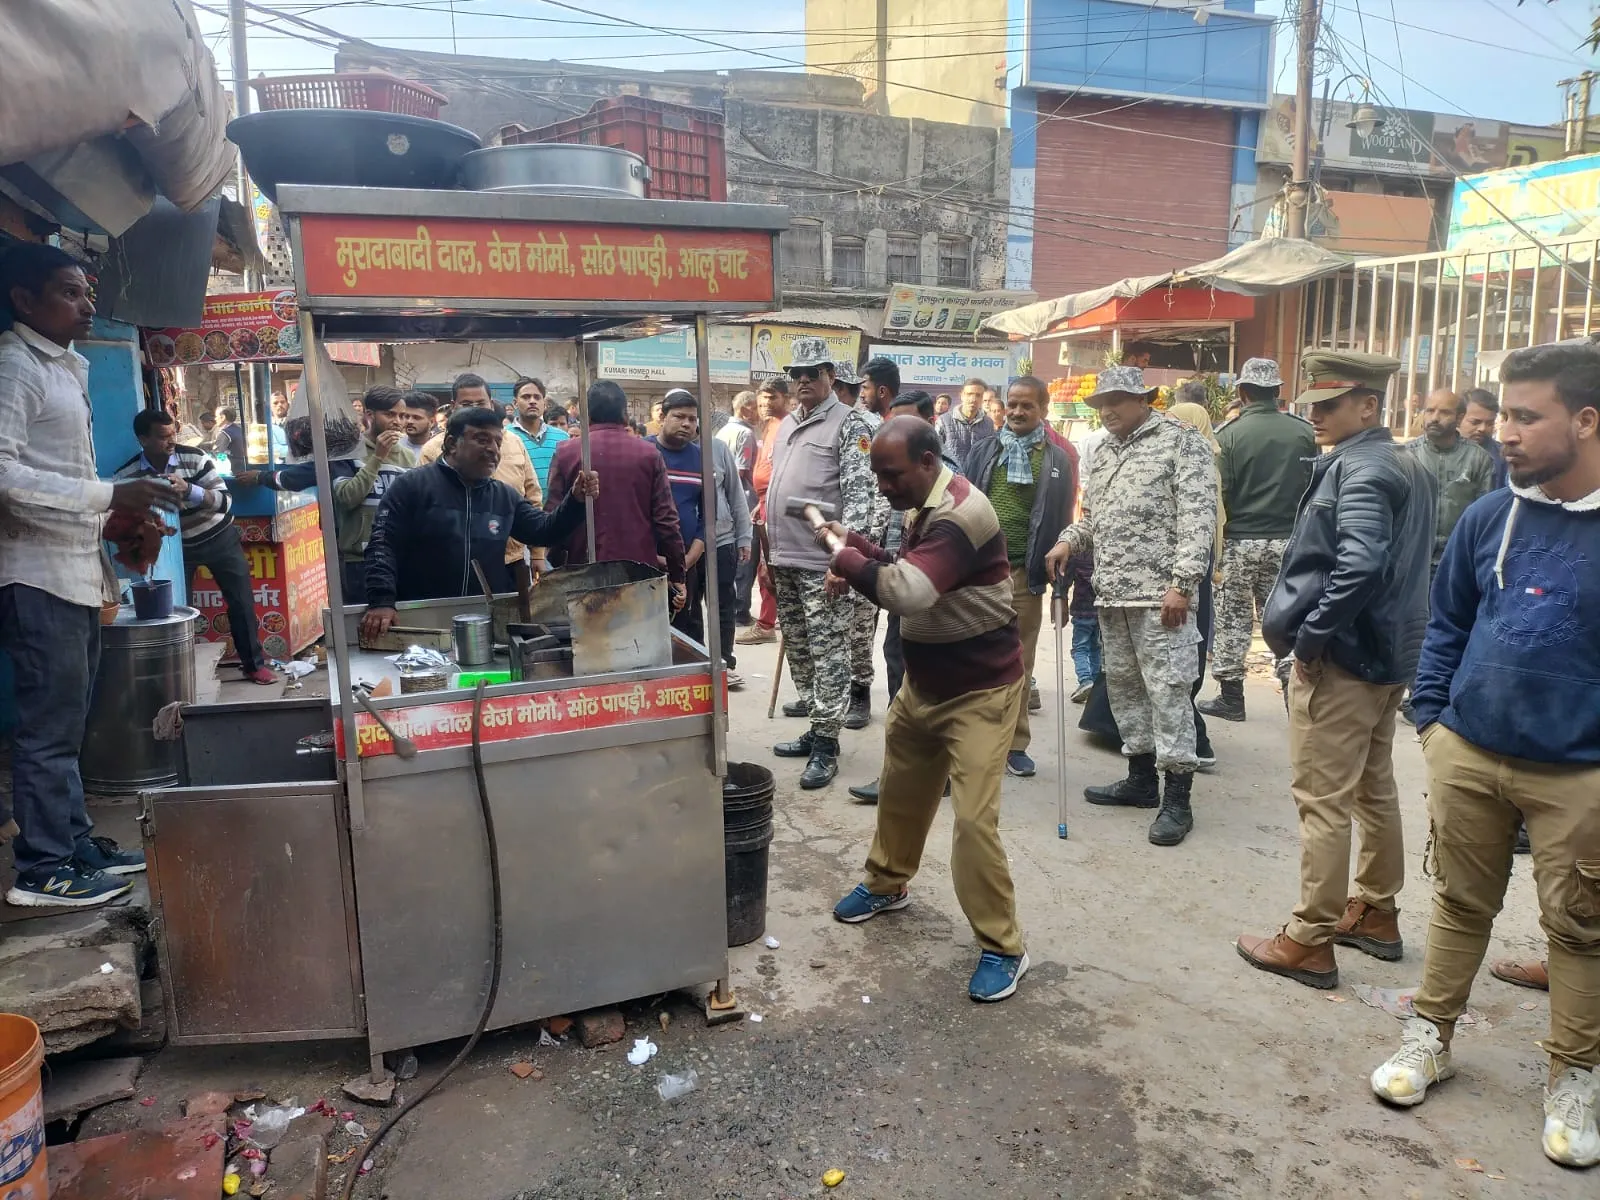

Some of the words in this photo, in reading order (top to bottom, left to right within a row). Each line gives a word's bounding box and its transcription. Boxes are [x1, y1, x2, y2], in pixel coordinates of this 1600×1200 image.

[1361, 133, 1422, 155] WOODLAND
[334, 225, 433, 288] मुरादाबादी
[435, 240, 483, 275] दाल,
[486, 229, 522, 272] वेज
[525, 230, 575, 278] मोमो,
[580, 232, 617, 276] सोठ
[678, 247, 719, 293] आलू
[717, 249, 749, 280] चाट
[604, 366, 628, 375] KUMARI
[917, 351, 968, 372] आयुर्वेद
[971, 356, 1006, 369] भवन
[482, 703, 513, 729] वेज
[567, 692, 599, 719] सोठ
[655, 684, 693, 713] आलू
